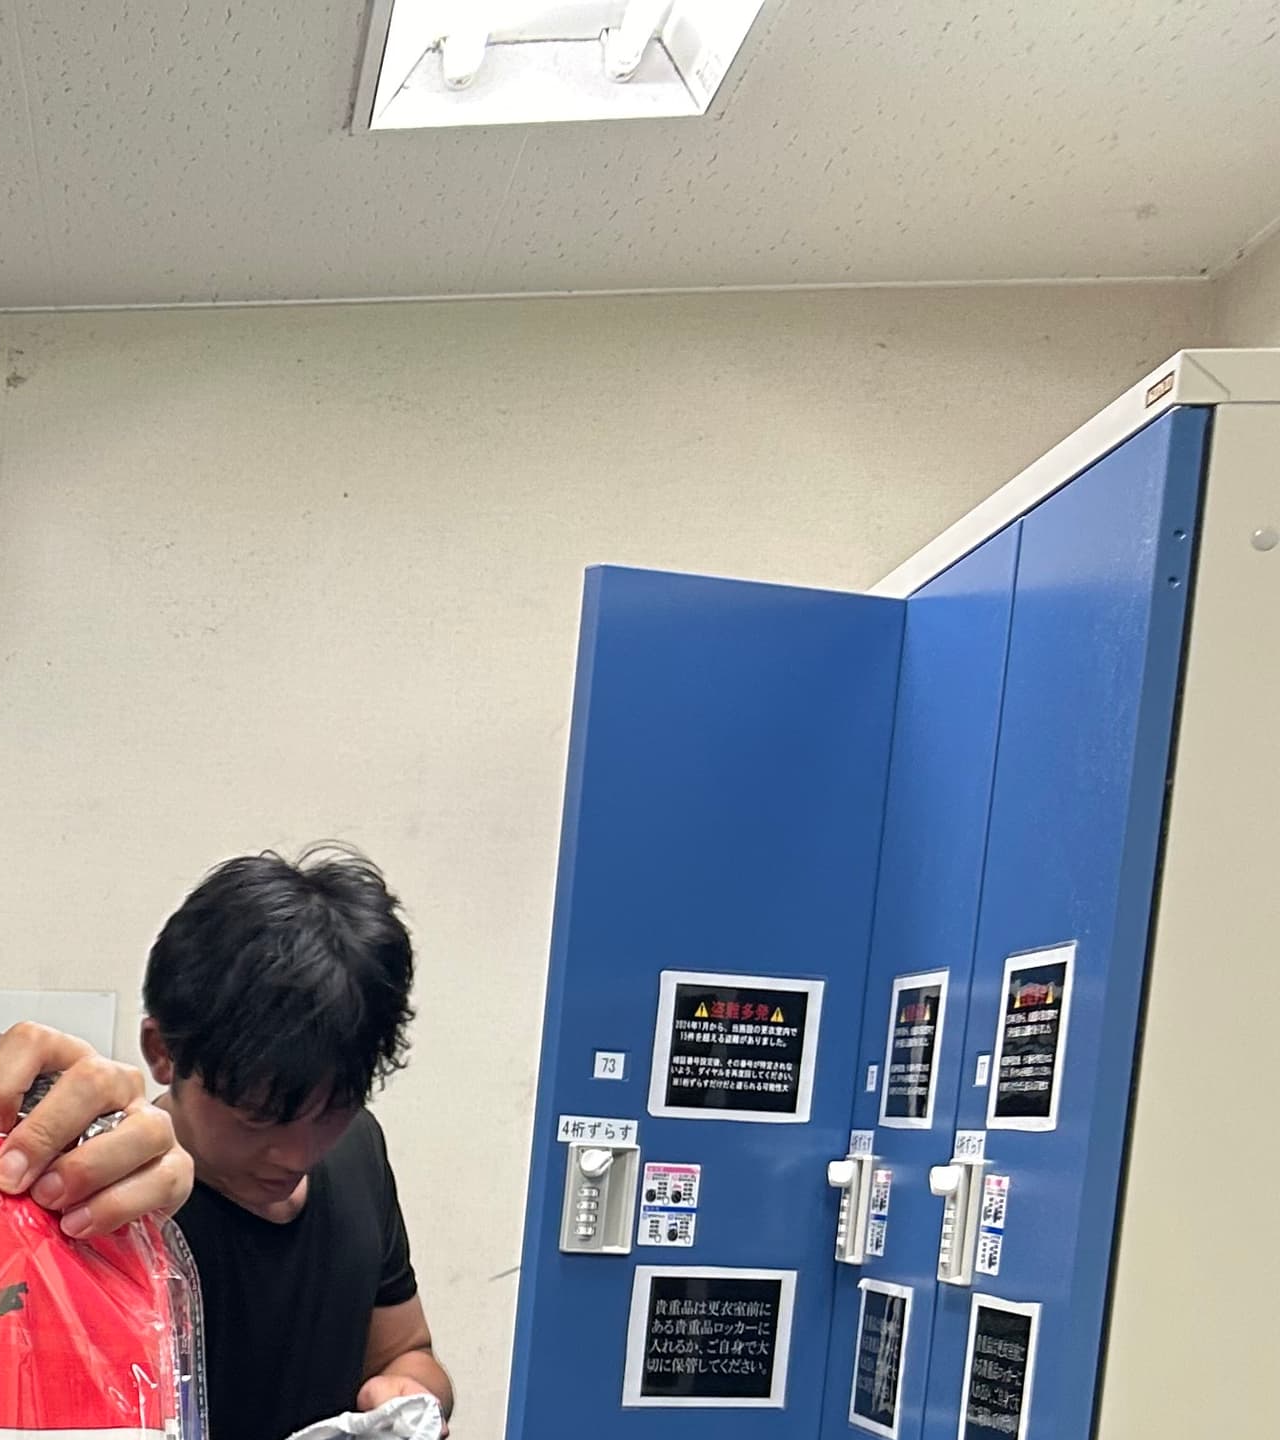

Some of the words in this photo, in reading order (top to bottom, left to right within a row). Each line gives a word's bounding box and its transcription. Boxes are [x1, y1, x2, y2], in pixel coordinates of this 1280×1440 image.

[601, 1057, 616, 1074] 73
[561, 1120, 633, 1141] 4桁ずらす
[654, 1299, 772, 1317] 貴重品は更衣室前に
[650, 1319, 771, 1336] ある貴重品ロッカーに
[647, 1338, 769, 1356] 入れるか、ご自身で大
[645, 1357, 768, 1376] 切に保管してください。
